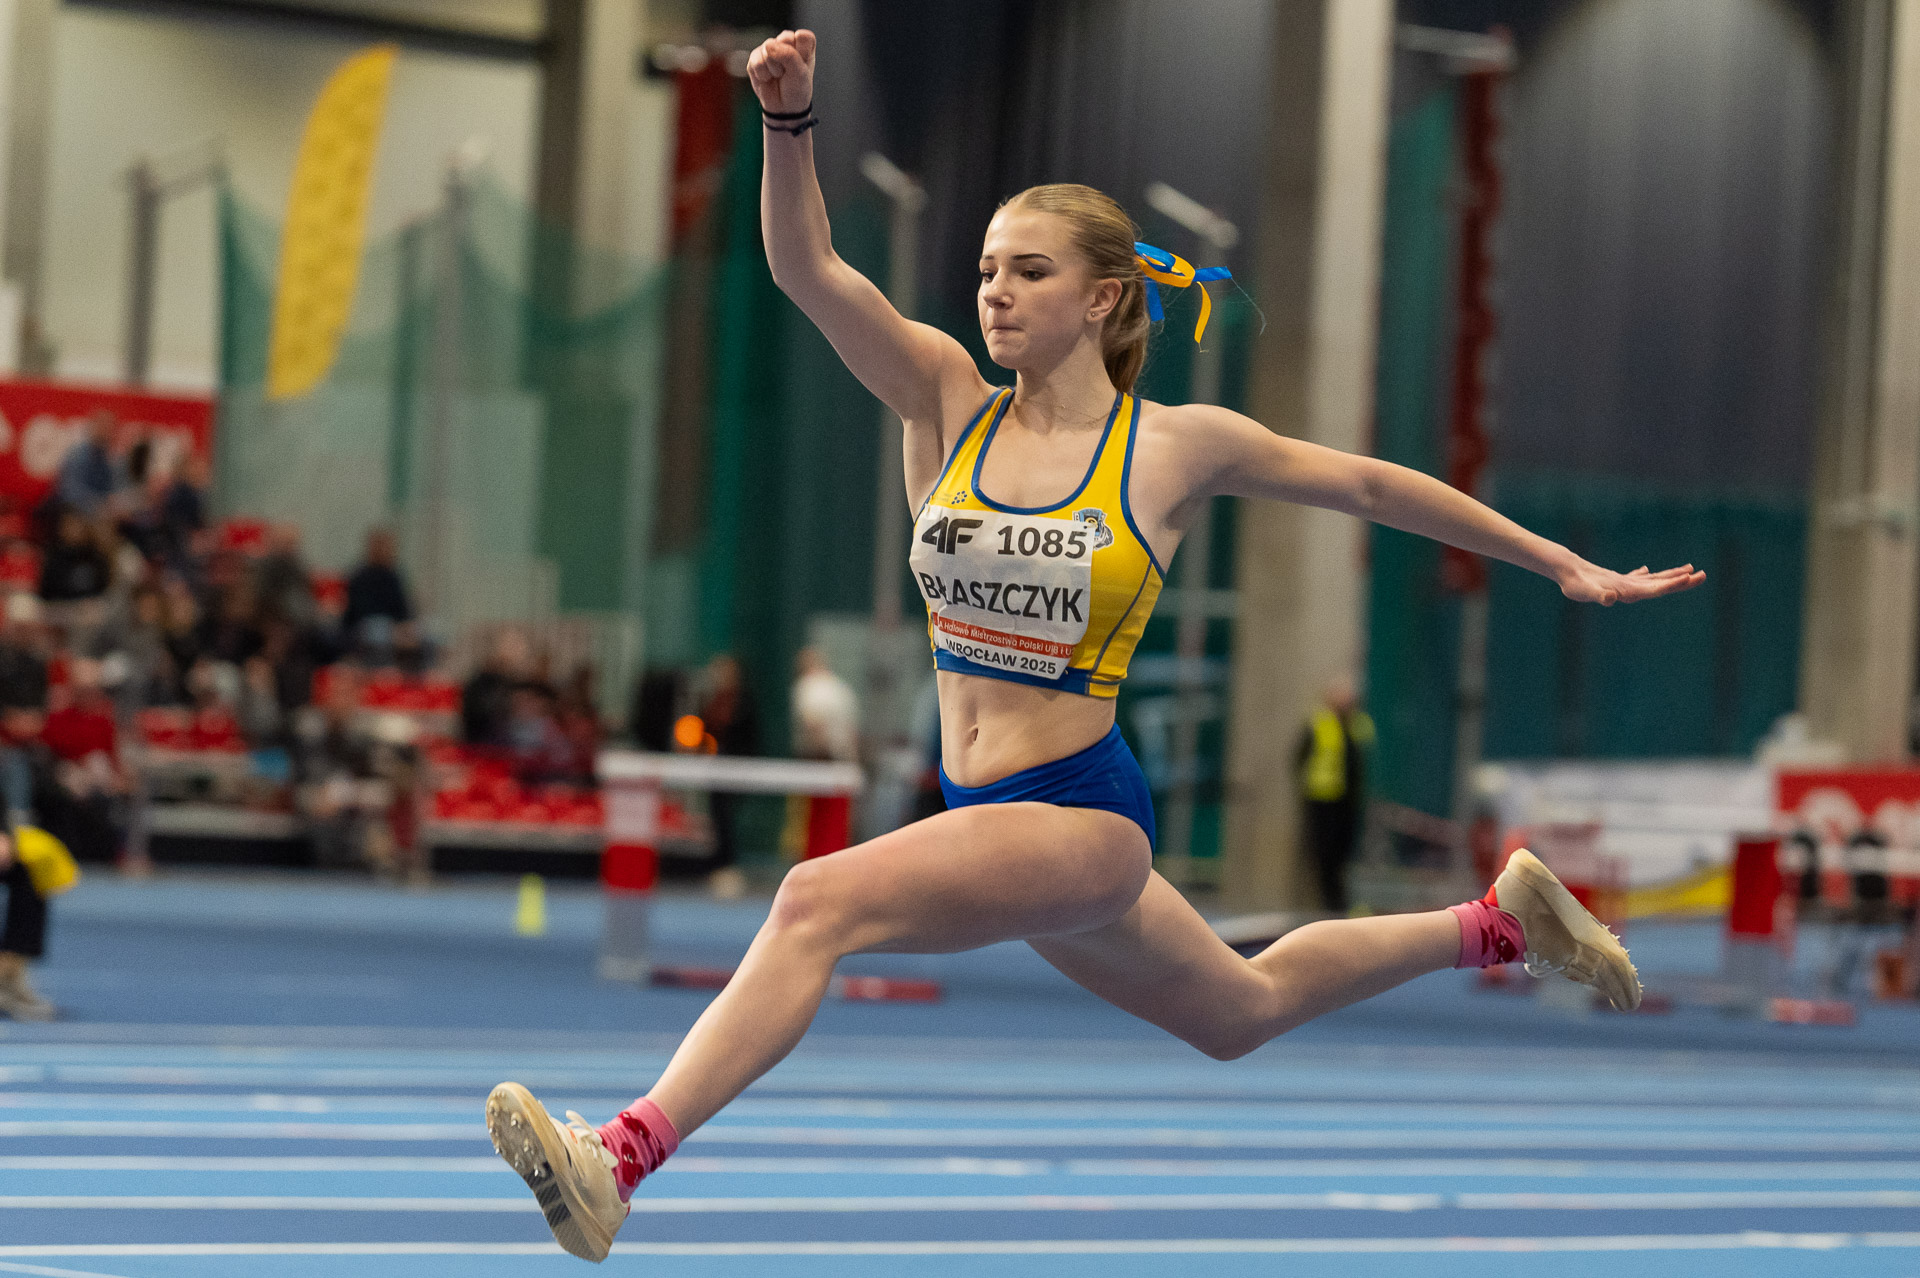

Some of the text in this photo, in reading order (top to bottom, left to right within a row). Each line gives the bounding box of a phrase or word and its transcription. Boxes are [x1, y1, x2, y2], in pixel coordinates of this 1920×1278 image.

[921, 516, 1087, 559] 4F 1085
[918, 571, 1084, 623] BŁASZCZYK
[946, 638, 1056, 675] WROCŁAW 2025
[970, 628, 1017, 647] Mistrzostwa
[1019, 639, 1044, 652] Polski
